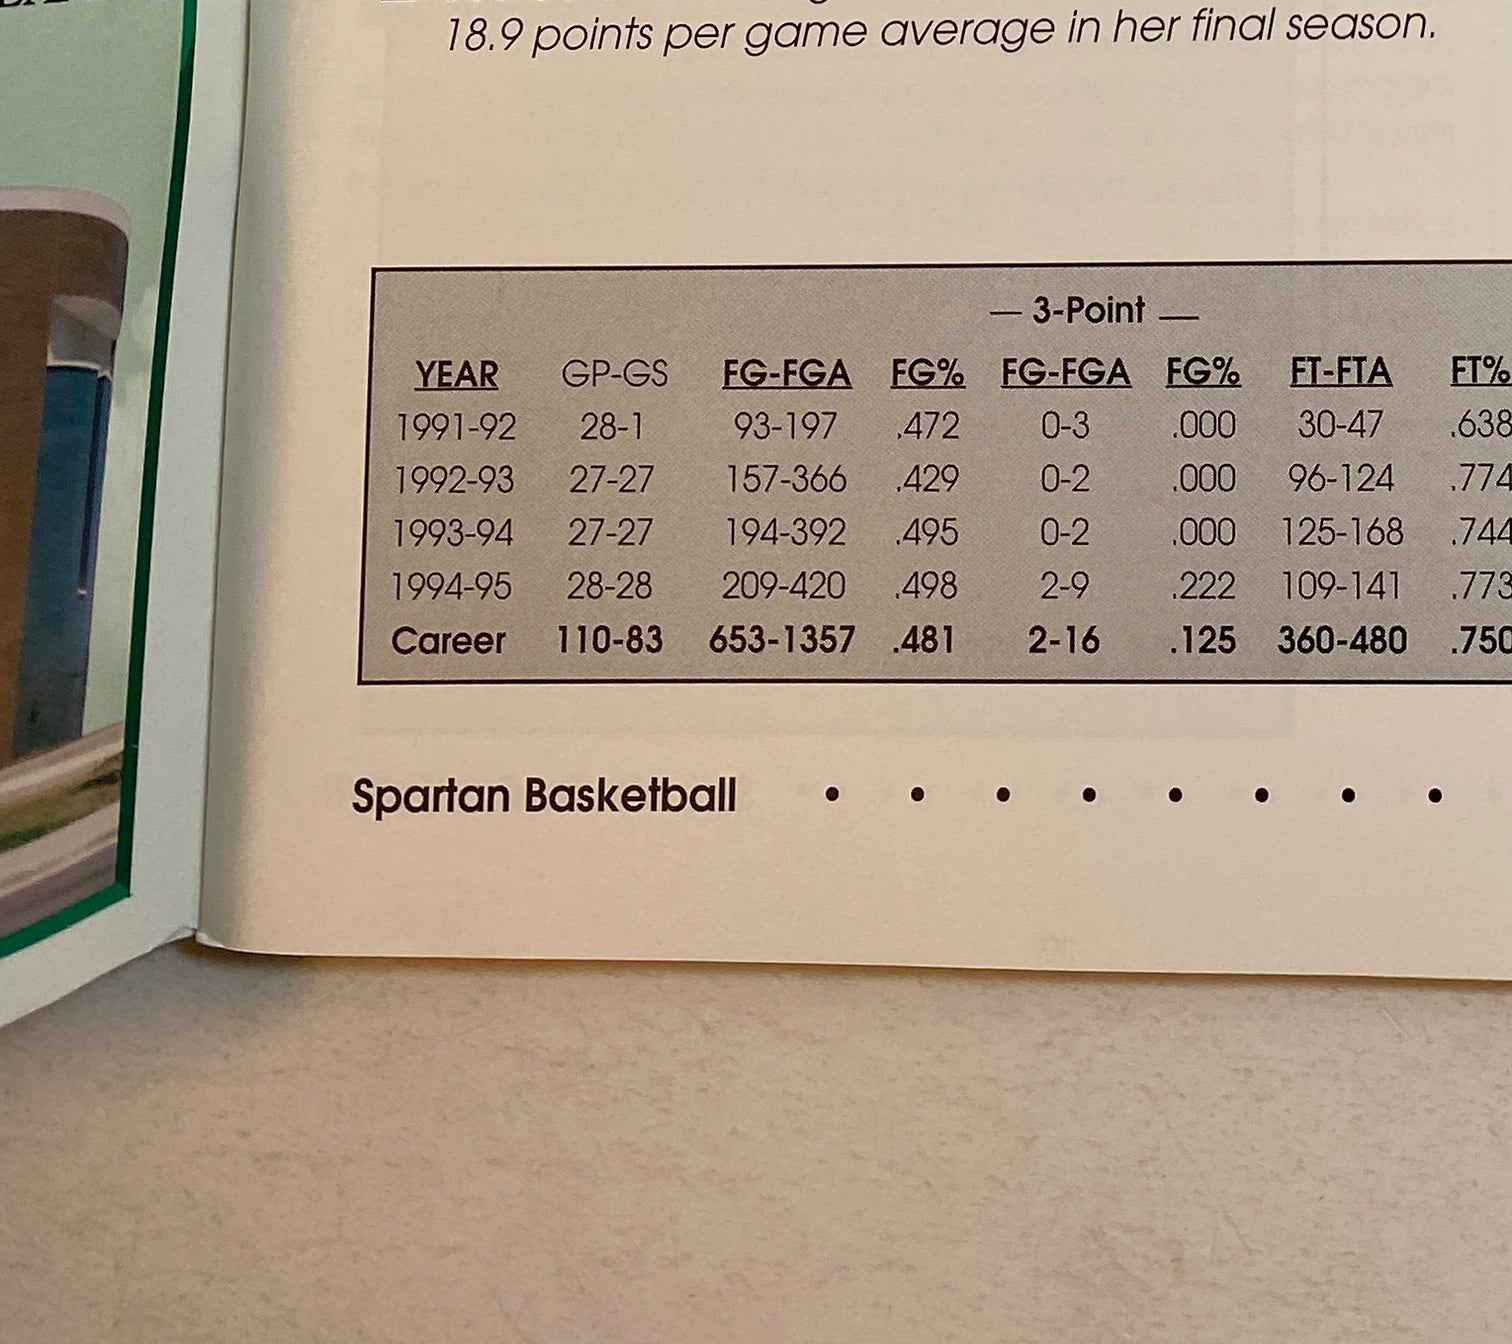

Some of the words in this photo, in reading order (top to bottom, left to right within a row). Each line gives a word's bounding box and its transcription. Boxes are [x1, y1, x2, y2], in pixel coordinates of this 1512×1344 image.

[1033, 295, 1145, 323] 3-Point
[414, 360, 499, 387] YEAR
[562, 359, 668, 387] GP-GS
[722, 359, 853, 386] FG-FGA
[890, 358, 966, 385] FG%
[1000, 357, 1133, 385] FG-FGA
[1165, 357, 1242, 385] FG%
[1290, 356, 1393, 383] FT-FTA
[1450, 355, 1512, 383] FT%
[398, 412, 516, 441] 1991-92
[581, 412, 640, 440] 28-1
[735, 412, 837, 440] 93-197
[898, 411, 959, 439] .472
[1042, 410, 1089, 439] 0-3
[1173, 410, 1235, 439] .000
[1298, 409, 1383, 438] 30-47
[392, 626, 506, 655] Career
[559, 625, 663, 654] 110-83
[710, 625, 855, 653] 653-1357
[893, 625, 952, 653] .481
[1029, 625, 1100, 654] 2-16
[1171, 625, 1236, 654] .125
[1277, 625, 1407, 654] 360-480
[352, 778, 509, 821] Spartan
[526, 777, 736, 812] Basketball
